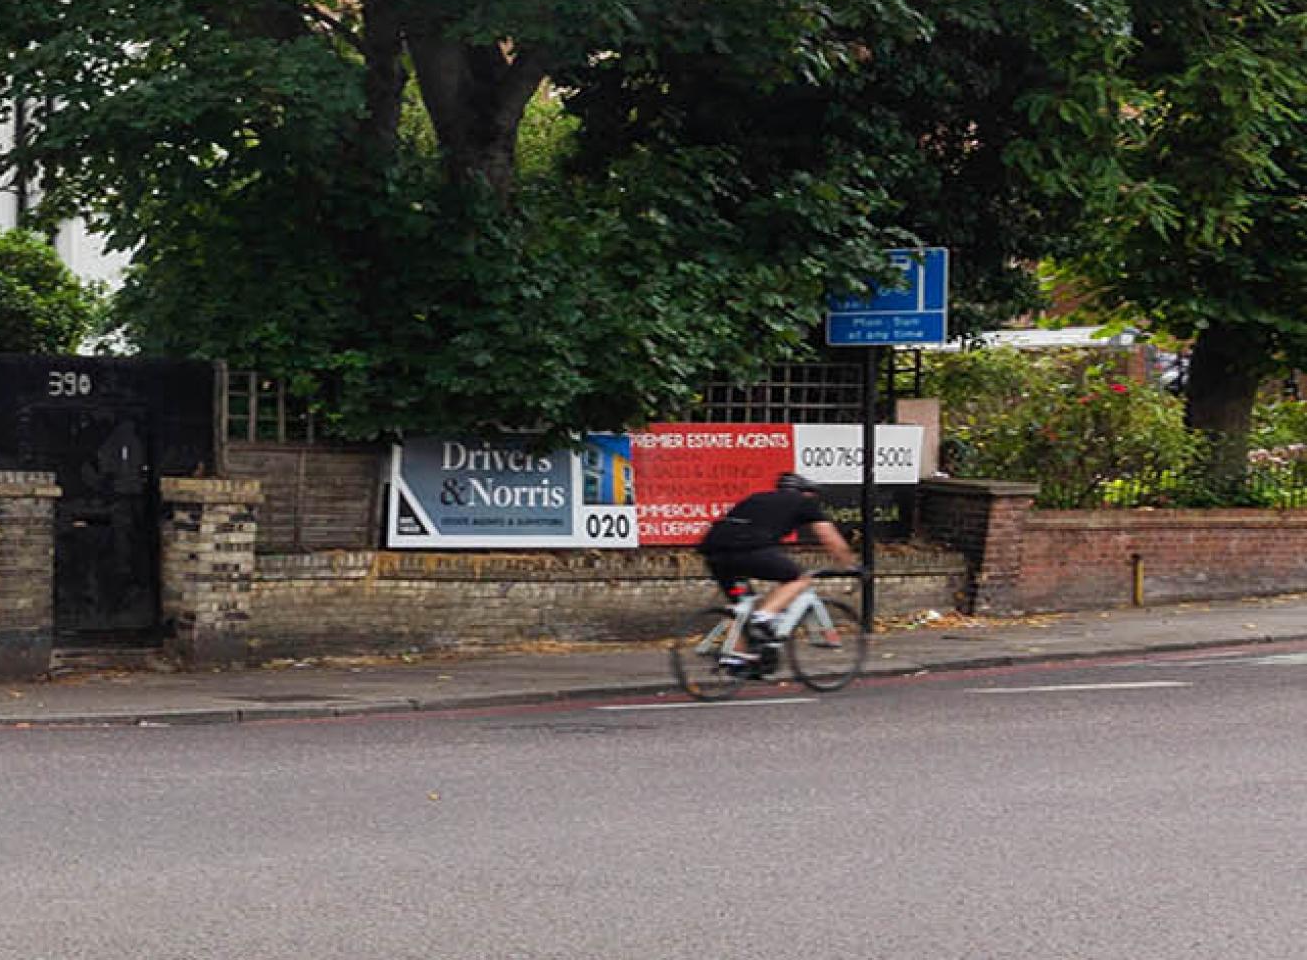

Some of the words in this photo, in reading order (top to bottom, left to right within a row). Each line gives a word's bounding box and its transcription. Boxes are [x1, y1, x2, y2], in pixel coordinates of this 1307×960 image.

[48, 371, 91, 395] 390
[632, 433, 684, 448] PREMIER
[688, 433, 733, 448] ESTATE
[736, 433, 788, 448] AGENTS
[441, 442, 552, 472] Drivers
[636, 503, 708, 518] OMMERCIAL
[586, 515, 629, 538] 020
